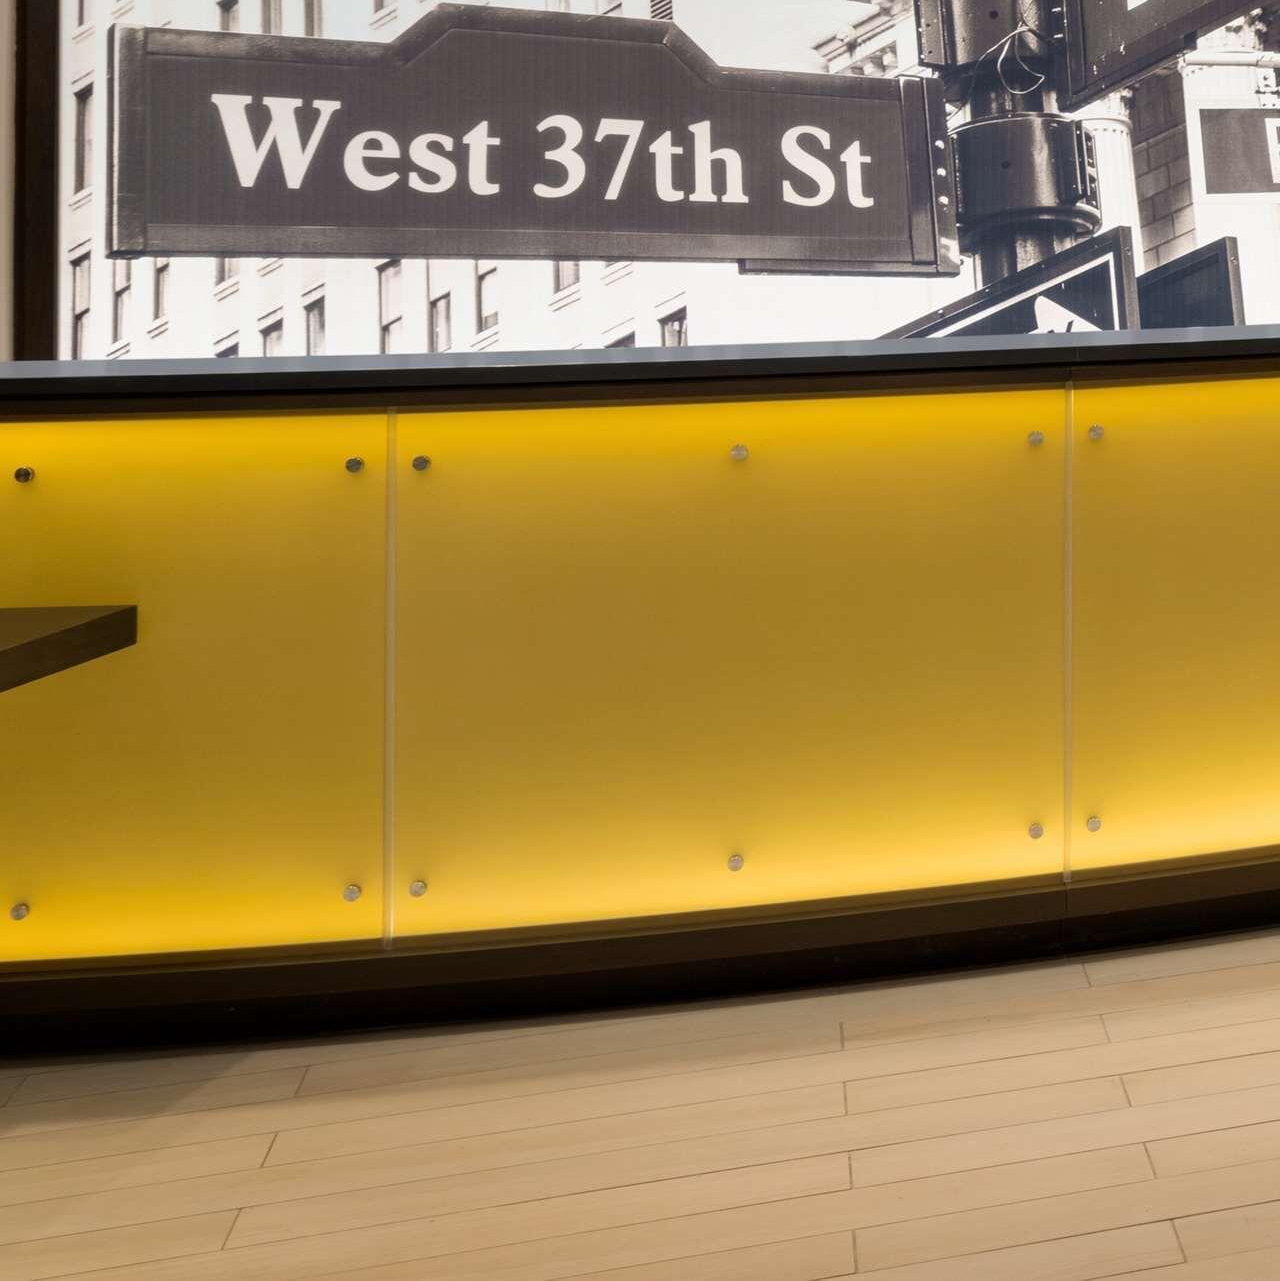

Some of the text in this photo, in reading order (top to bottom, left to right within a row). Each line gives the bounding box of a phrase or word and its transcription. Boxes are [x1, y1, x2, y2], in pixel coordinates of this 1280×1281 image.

[211, 93, 876, 209] West 37th St
